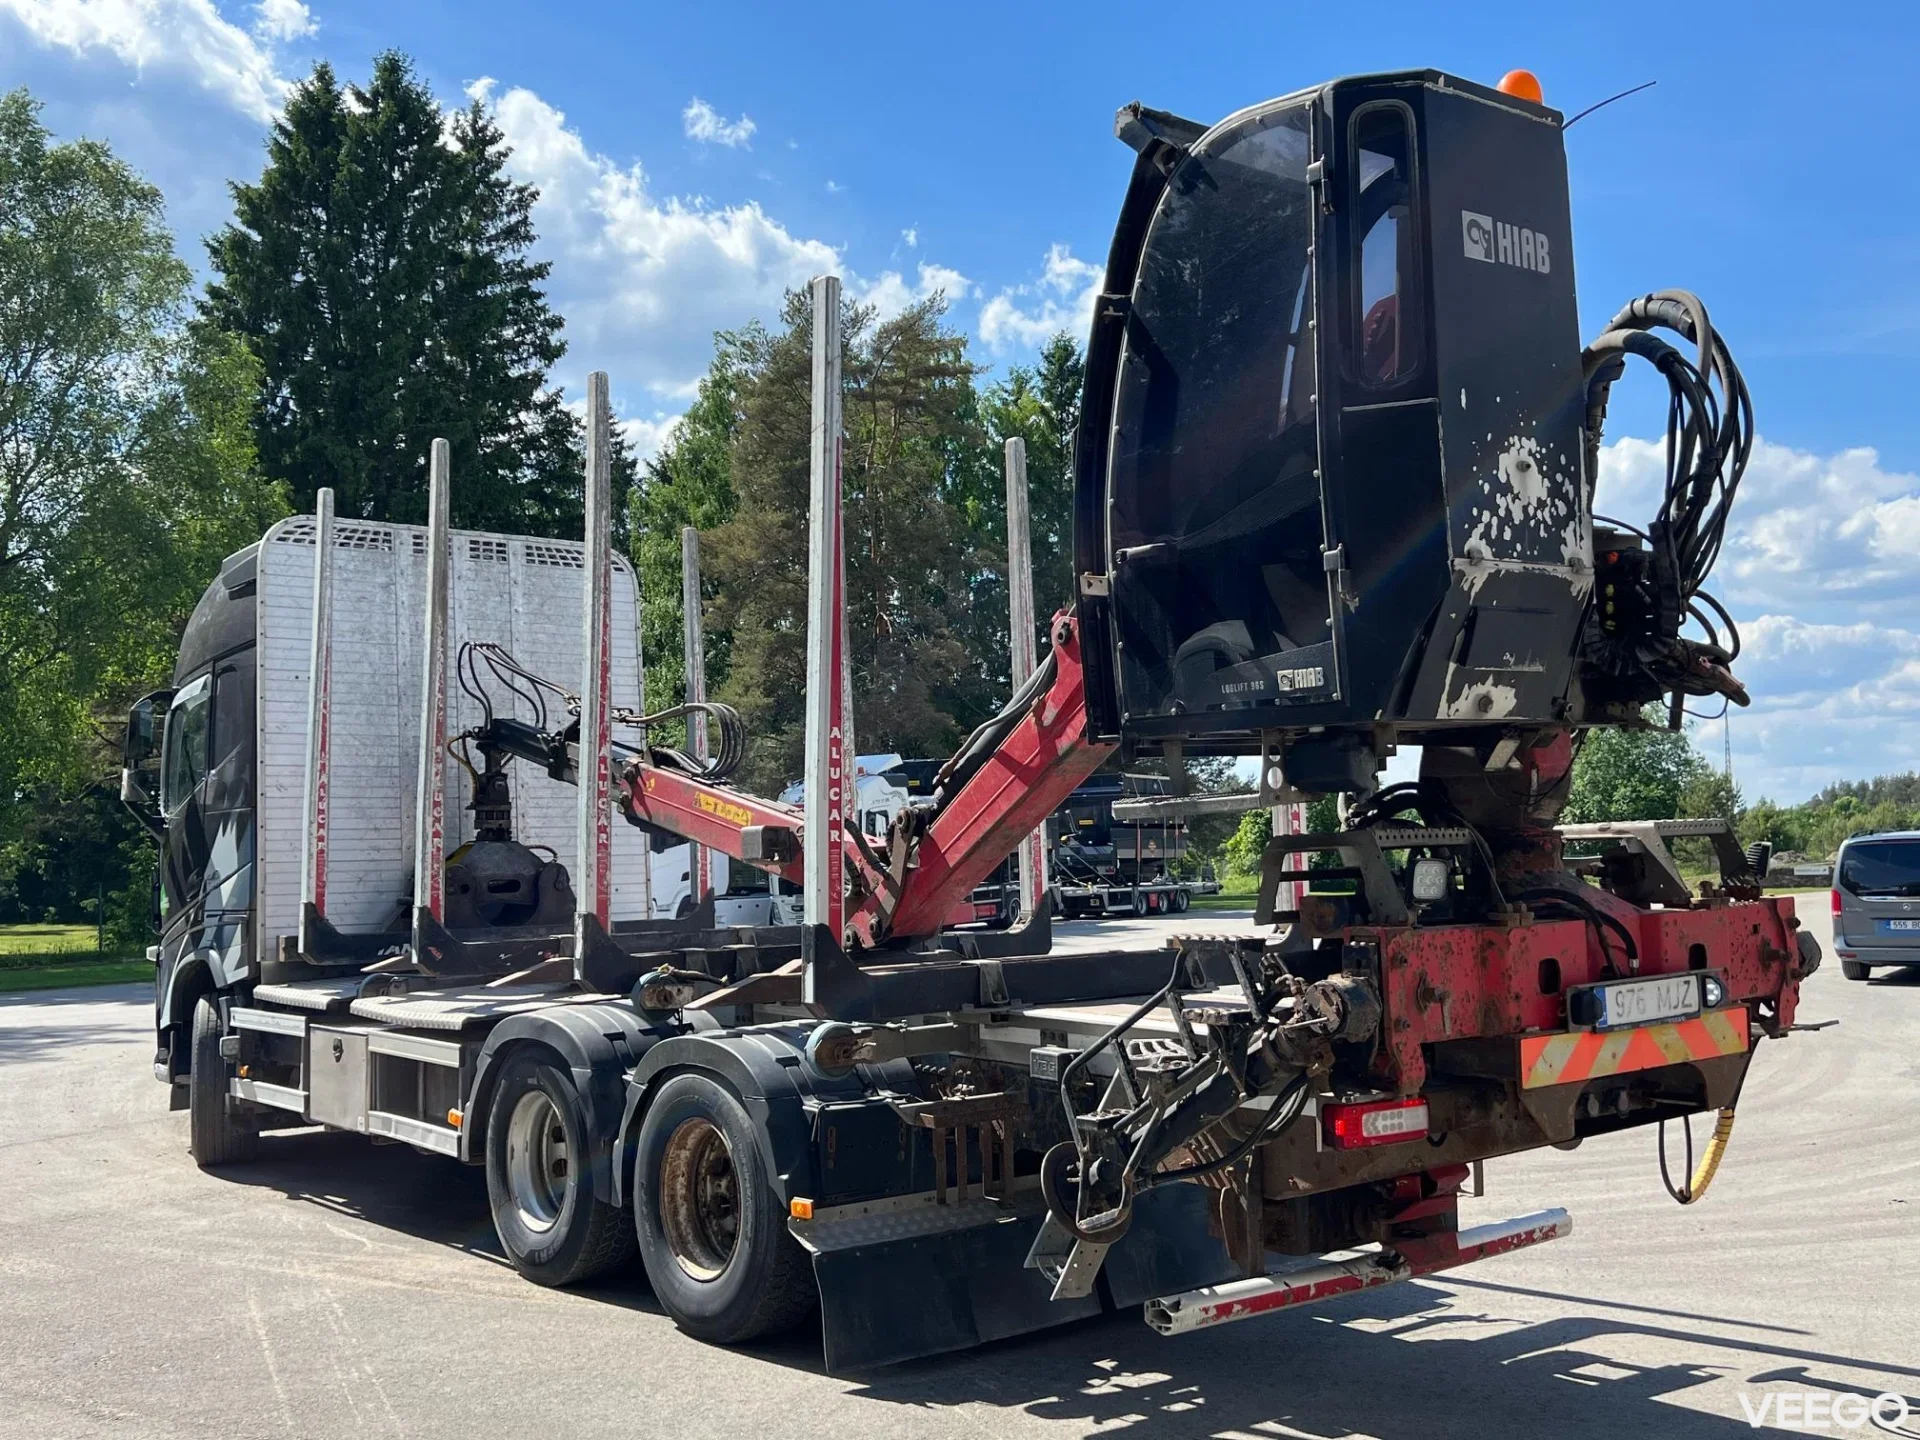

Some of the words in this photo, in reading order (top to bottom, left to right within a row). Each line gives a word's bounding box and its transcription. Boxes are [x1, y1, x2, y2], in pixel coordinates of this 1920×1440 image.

[1496, 221, 1551, 274] HIAB
[1294, 666, 1324, 688] HIAB
[317, 774, 326, 850] ALUCAR
[598, 747, 608, 844] ALUCAR
[829, 726, 842, 843] ALUCAR
[1615, 988, 1646, 1018] 976
[1657, 980, 1692, 1013] MJZ
